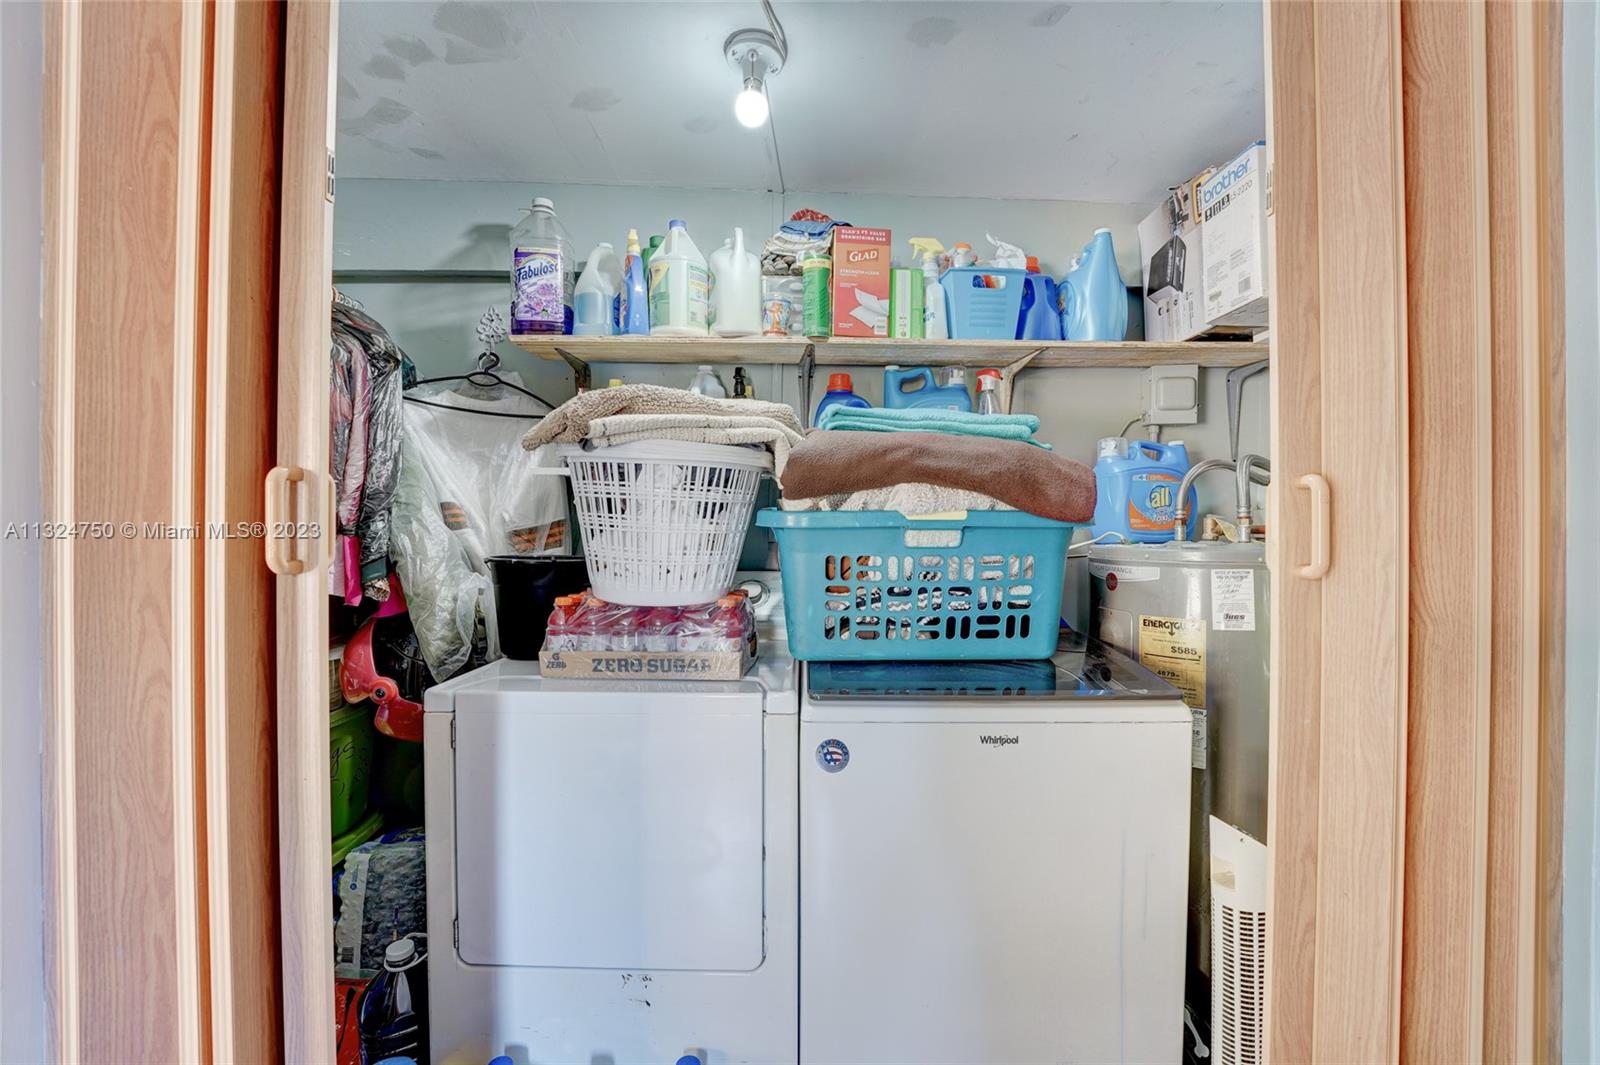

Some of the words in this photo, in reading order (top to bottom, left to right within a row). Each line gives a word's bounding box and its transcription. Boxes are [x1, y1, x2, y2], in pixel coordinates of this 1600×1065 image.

[1204, 158, 1250, 203] brother
[849, 250, 878, 262] GLAD
[516, 263, 559, 282] Fabuloso
[1151, 487, 1169, 508] all
[1170, 646, 1198, 656] $585
[546, 660, 567, 669] ZERO
[592, 658, 643, 673] ZERO
[647, 658, 711, 673] SUGAR
[820, 739, 849, 757] AMERICA
[979, 734, 1019, 748] Whirlpool
